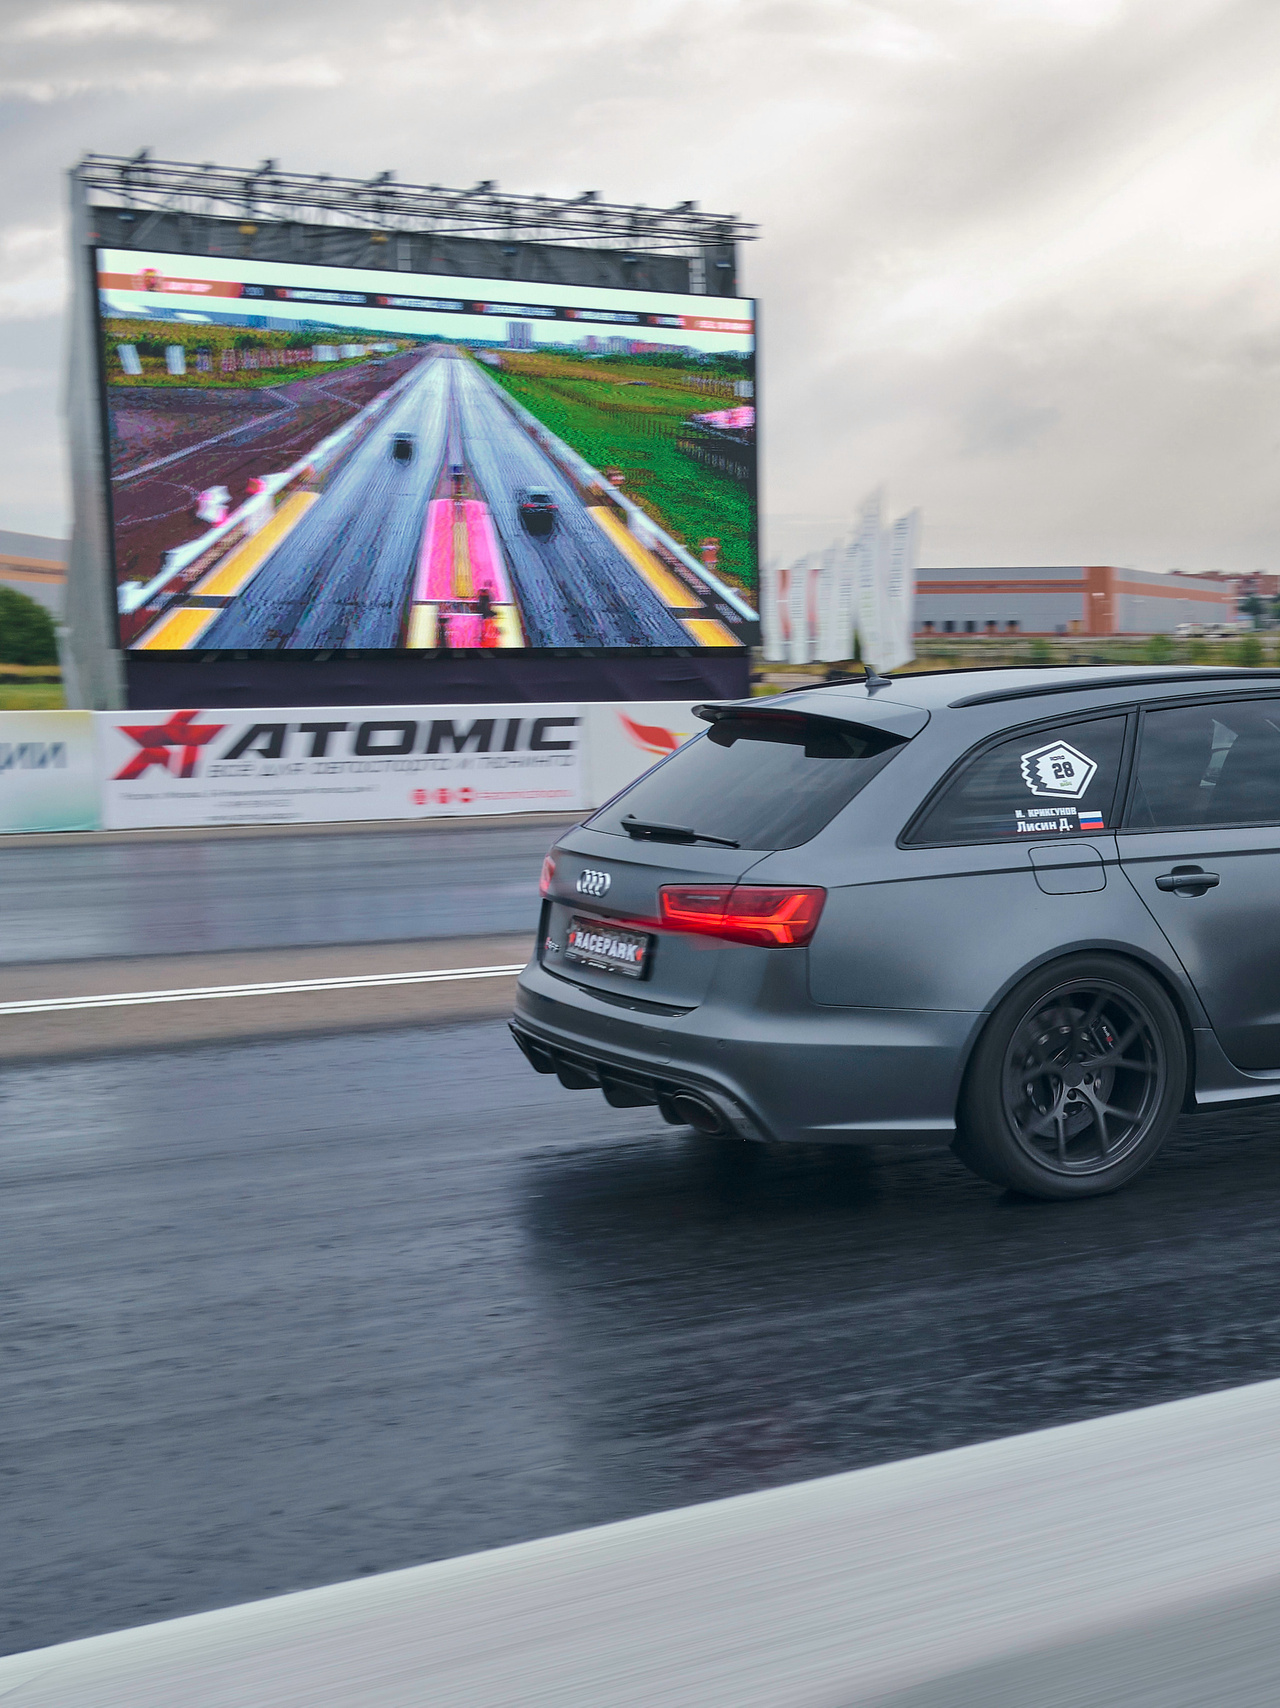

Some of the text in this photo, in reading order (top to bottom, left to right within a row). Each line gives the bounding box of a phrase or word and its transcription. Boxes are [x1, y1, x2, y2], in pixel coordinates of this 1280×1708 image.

[217, 716, 581, 760] ATOMIC
[1052, 761, 1075, 779] 28
[1017, 817, 1074, 832] Лисин Д.
[574, 931, 639, 962] RACEPARK
